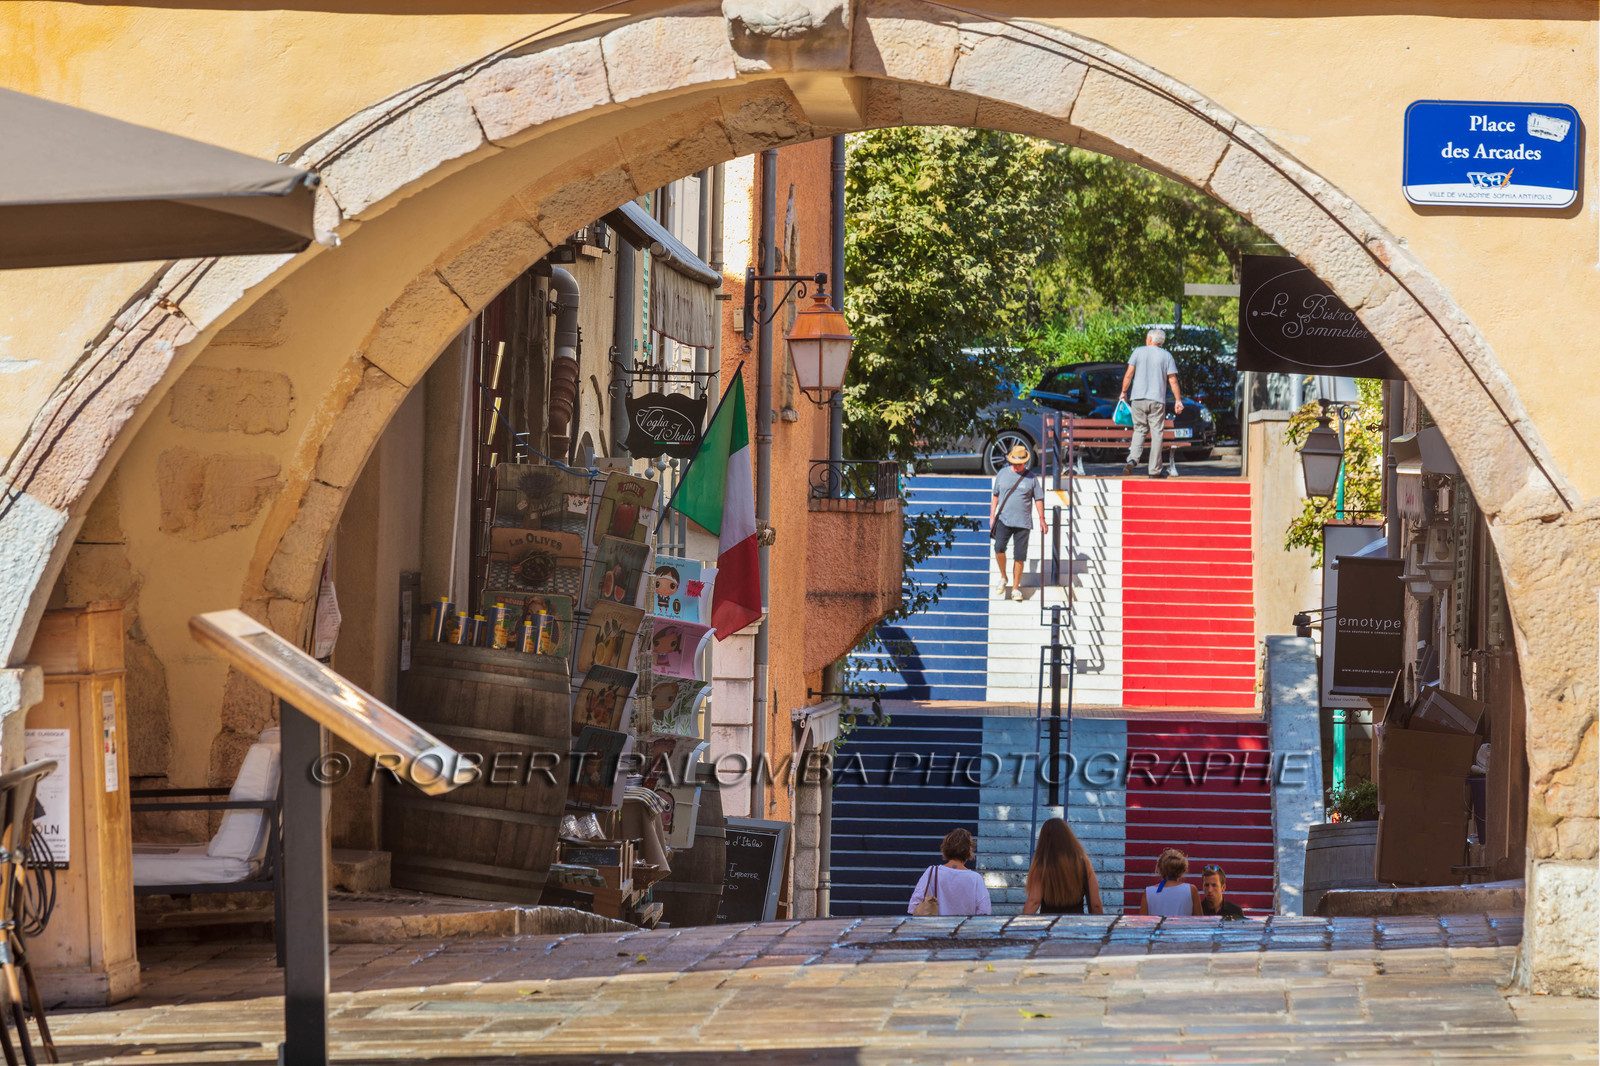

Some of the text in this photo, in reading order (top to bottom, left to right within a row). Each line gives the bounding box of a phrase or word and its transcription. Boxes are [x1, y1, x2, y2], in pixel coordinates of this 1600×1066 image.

[1469, 115, 1516, 132] Place
[1441, 142, 1542, 161] des Arcades
[1493, 192, 1517, 200] SOPHIA
[1518, 193, 1553, 201] ANTIPOLIS
[1261, 292, 1289, 318] Le
[1282, 315, 1368, 339] Sommelier
[637, 408, 669, 431] Voglia
[654, 423, 696, 442] d'Italia
[526, 532, 563, 551] OLIVES
[1338, 617, 1401, 630] emotype
